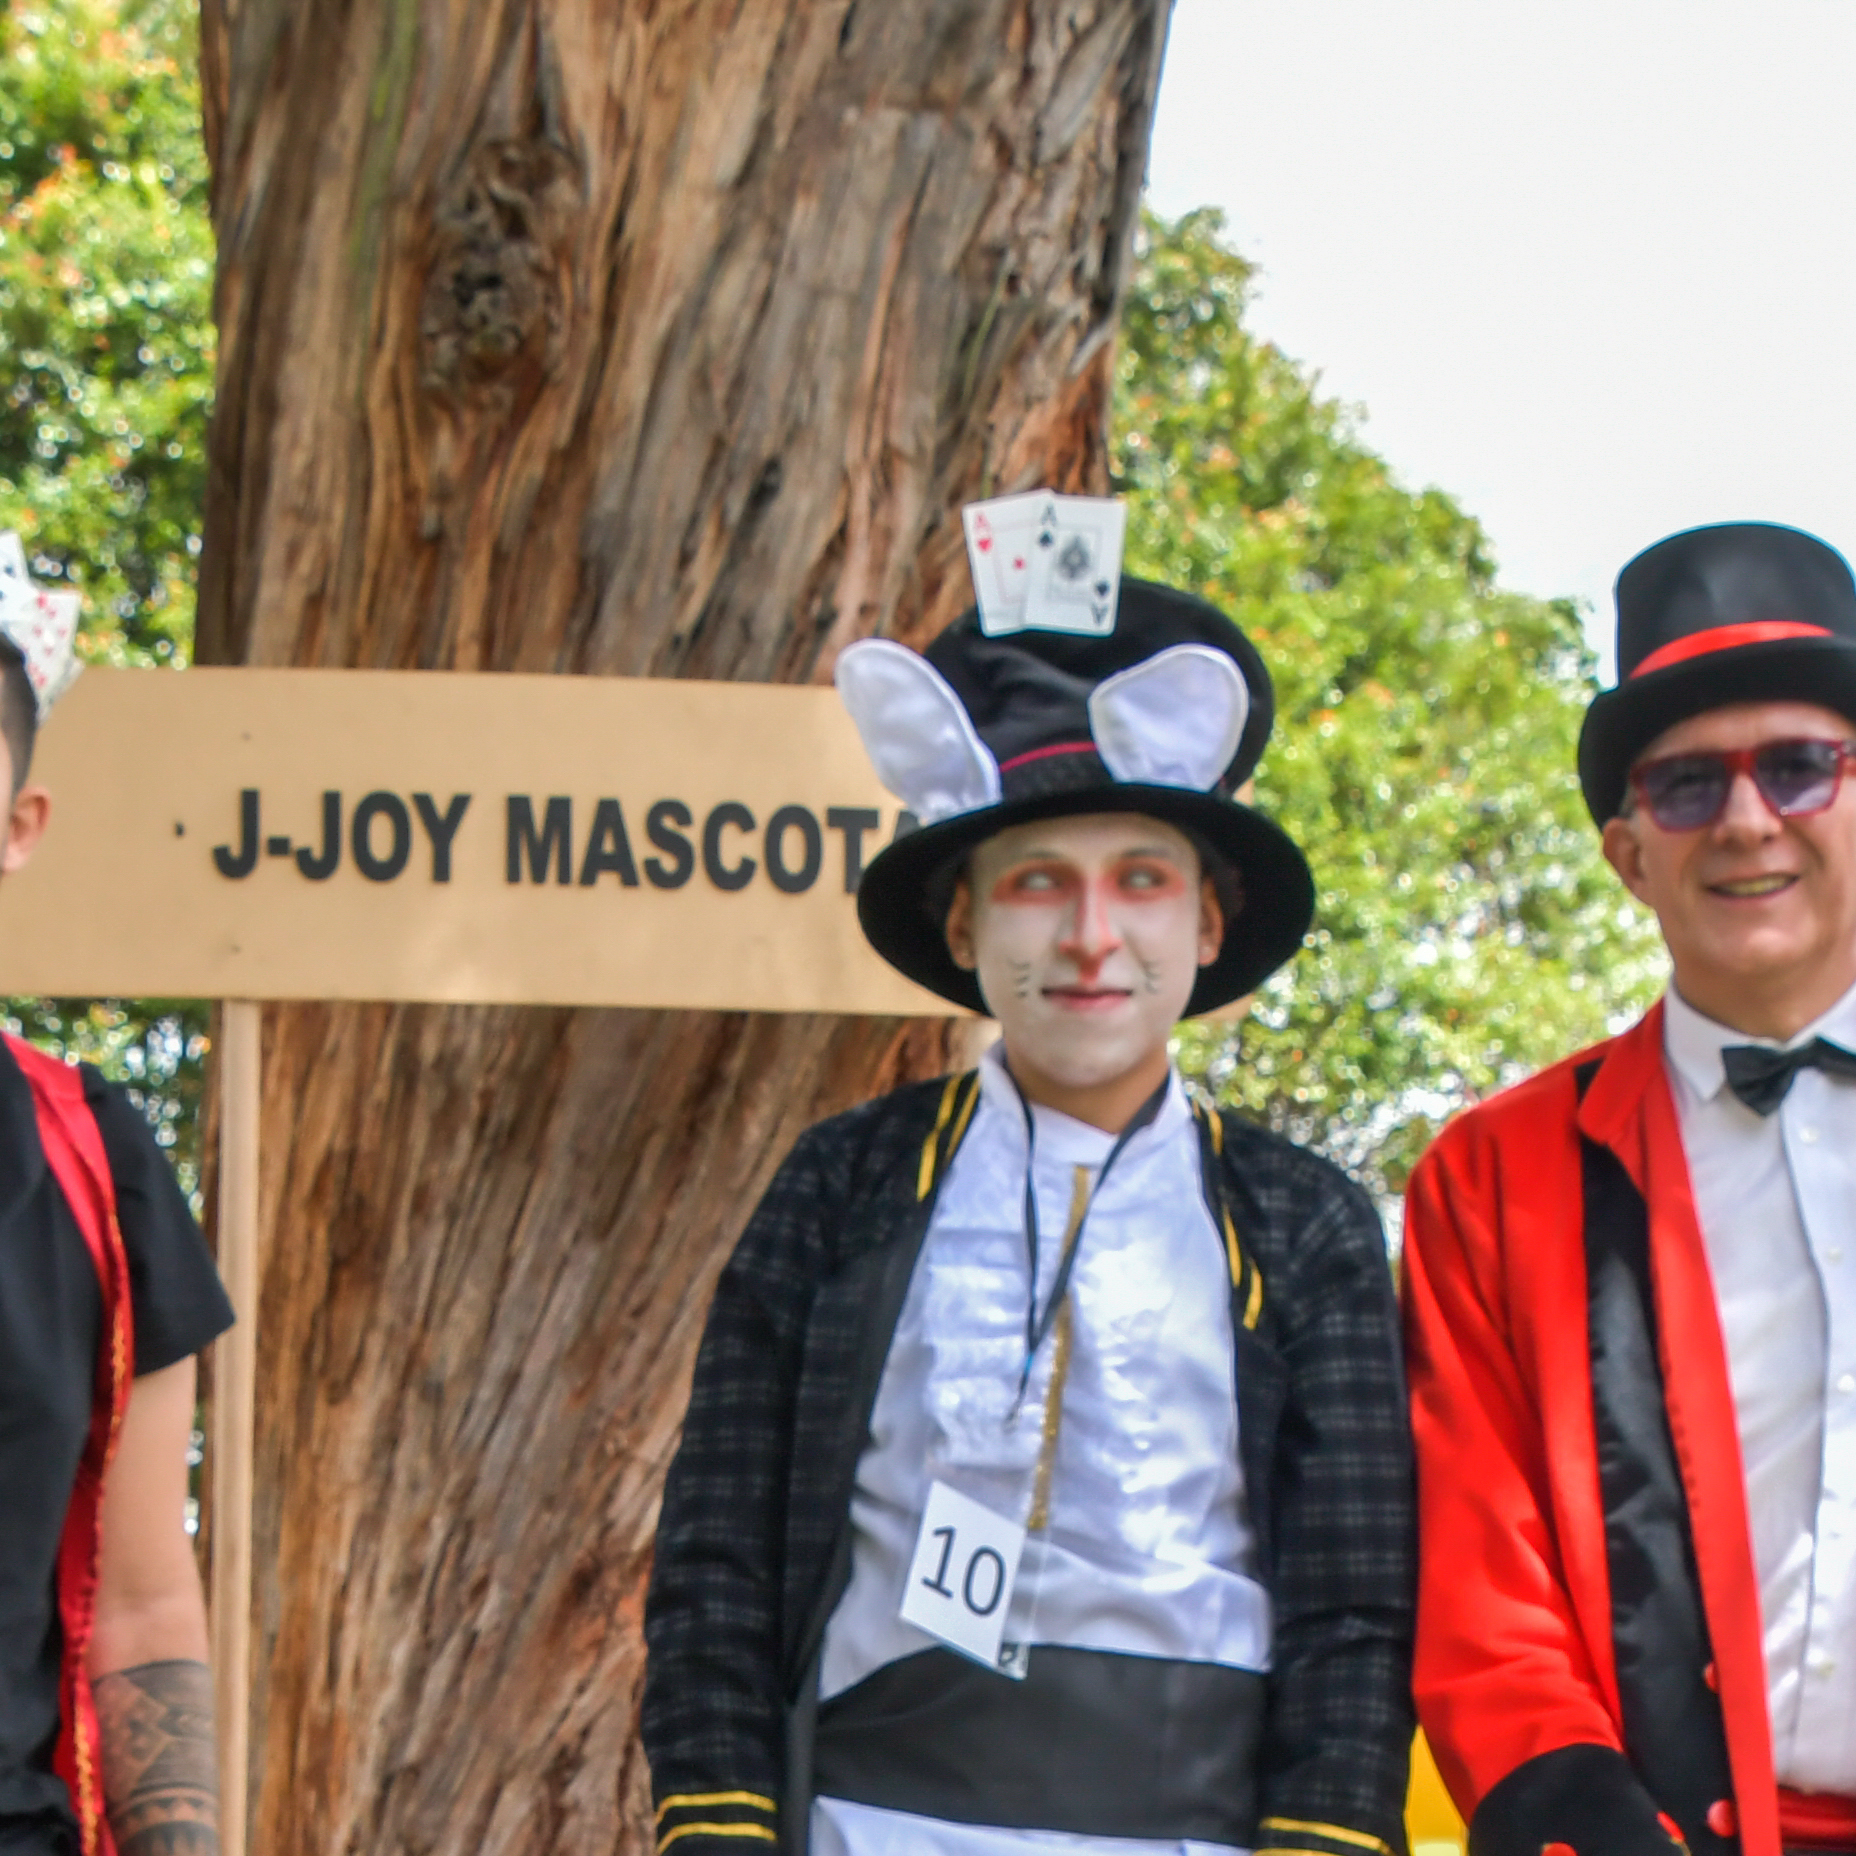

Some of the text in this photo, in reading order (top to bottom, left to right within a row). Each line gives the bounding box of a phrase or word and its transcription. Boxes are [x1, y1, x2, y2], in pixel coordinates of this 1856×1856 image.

[213, 788, 922, 893] J-JOY MASCOT
[921, 1524, 1007, 1617] 10
